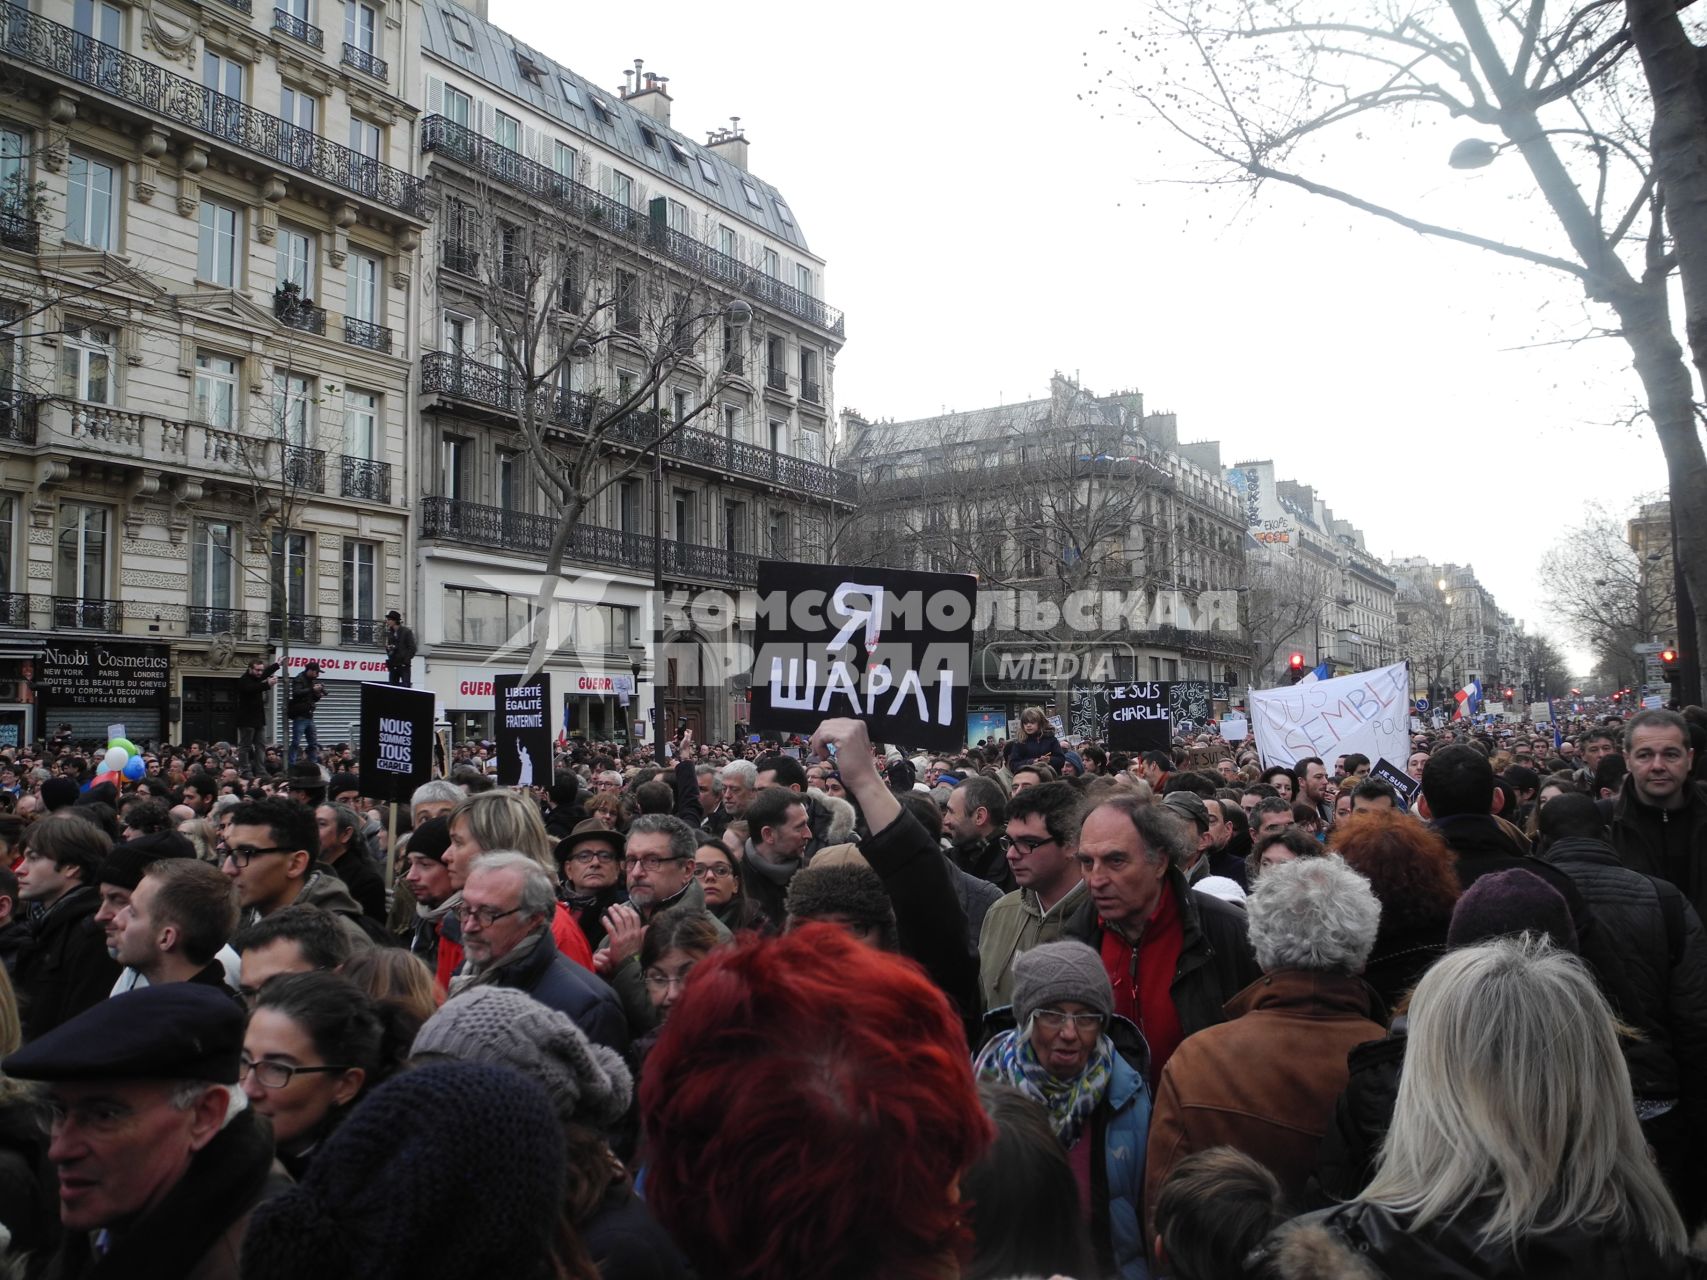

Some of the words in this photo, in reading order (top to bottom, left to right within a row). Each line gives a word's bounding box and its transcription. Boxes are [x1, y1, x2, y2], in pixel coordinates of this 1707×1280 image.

[826, 582, 884, 656] Я
[44, 648, 89, 666] Nnobi
[97, 650, 168, 668] Cosmetics
[44, 668, 60, 676] NEW
[343, 660, 357, 671] BY
[44, 678, 72, 686] TOUTES
[505, 683, 541, 698] LIBERTÉ
[1111, 686, 1126, 699] JE
[505, 698, 542, 711] ÉGALITÉ
[380, 718, 412, 736] NOUS
[506, 712, 542, 728] FRATERNITÉ
[379, 733, 411, 746] SOMMES
[379, 743, 411, 762] TOUS
[377, 760, 411, 772] CHARLIE
[1378, 769, 1390, 779] JE
[1389, 775, 1408, 791] SUIS
